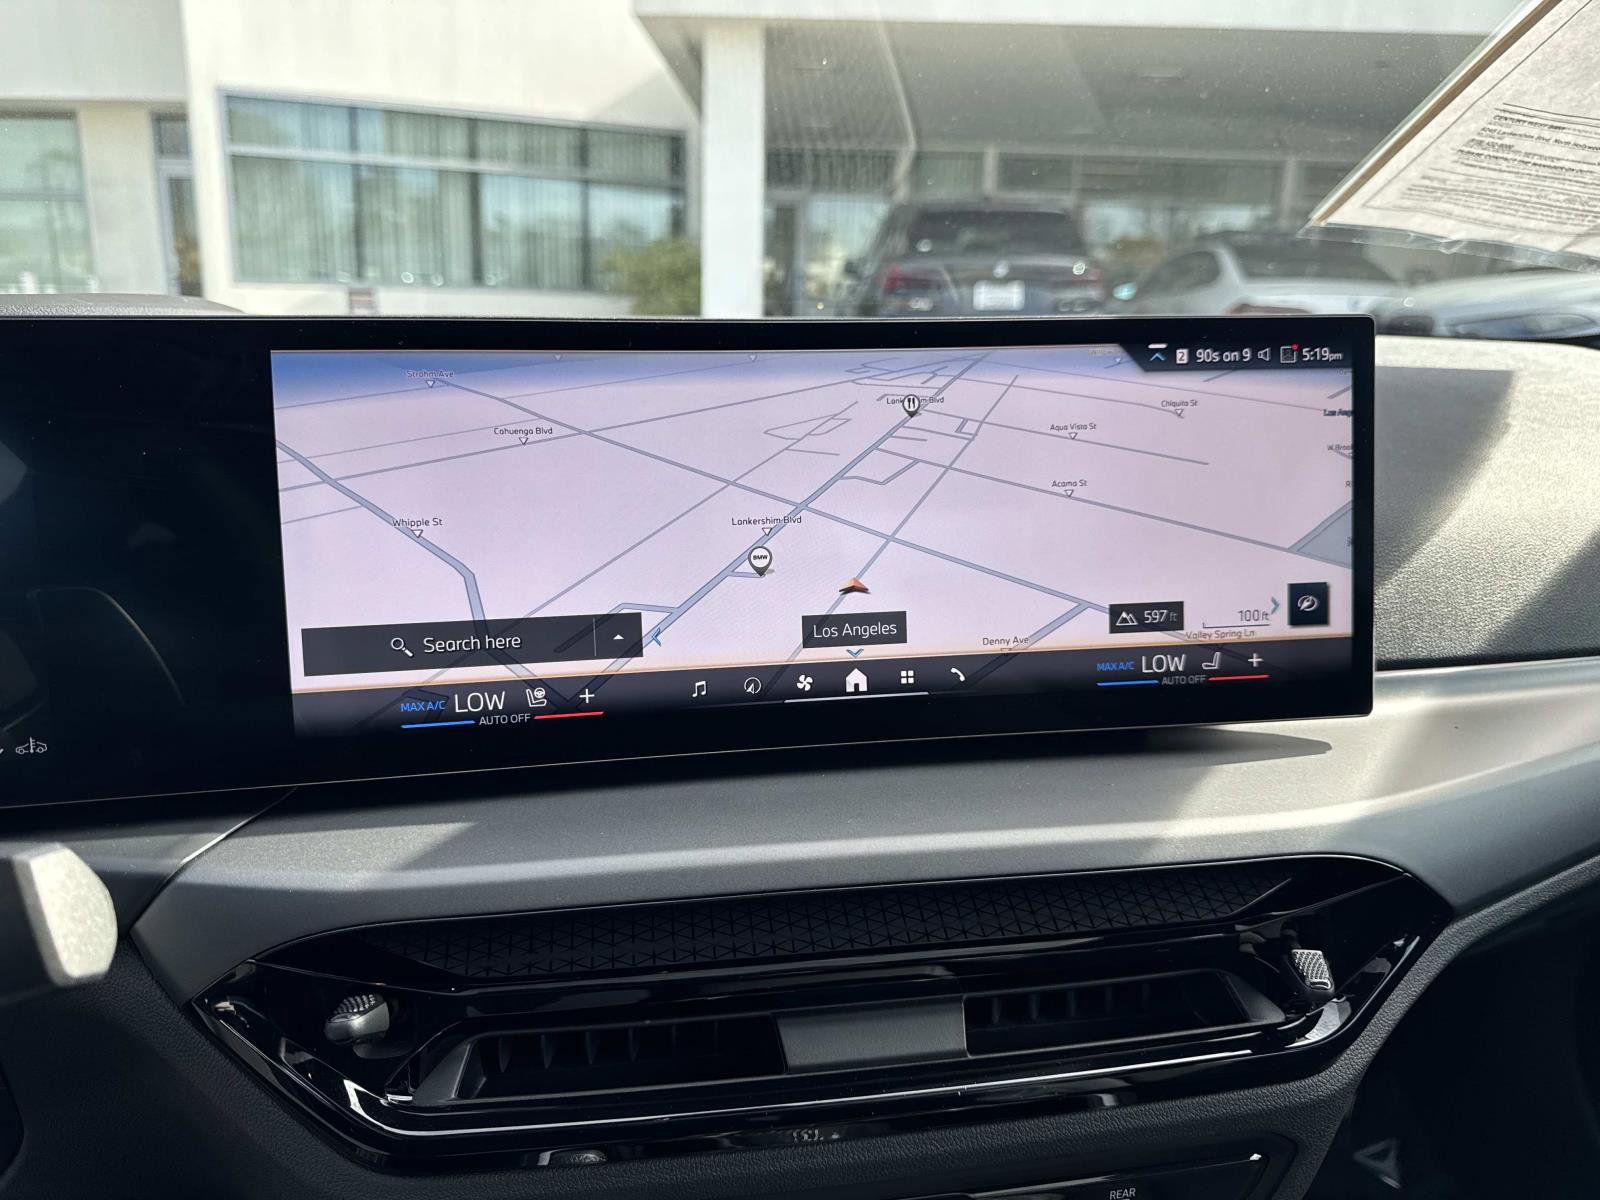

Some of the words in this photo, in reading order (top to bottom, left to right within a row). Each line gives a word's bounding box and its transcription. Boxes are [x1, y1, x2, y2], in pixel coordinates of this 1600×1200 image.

[1196, 349, 1219, 362] 90s
[1222, 351, 1239, 362] on
[1242, 348, 1250, 362] 9
[1190, 399, 1198, 407] St
[493, 427, 534, 436] Cahuenga
[535, 427, 553, 435] Blvd
[1069, 423, 1088, 431] Vista
[1052, 480, 1077, 488] Acama
[1079, 479, 1088, 487] St
[392, 519, 430, 529] Whipple
[432, 518, 443, 526] St
[731, 517, 782, 526] Lankershim
[783, 516, 802, 524] Blvd
[1144, 610, 1168, 624] 597
[1169, 611, 1178, 622] ft
[1238, 610, 1260, 622] 100
[813, 624, 838, 638] Los
[842, 622, 897, 639] Angeles
[1185, 631, 1213, 640] Valley
[1214, 630, 1242, 640] Spring
[423, 636, 481, 653] Search
[485, 635, 521, 649] here
[982, 638, 1011, 646] Denny
[1012, 636, 1029, 645] Ave
[1096, 663, 1117, 671] MAX
[1118, 661, 1135, 670] A/C
[1141, 653, 1187, 673] LOW
[1161, 676, 1186, 685] AUTO
[1187, 674, 1206, 683] OFF
[400, 702, 425, 712] MAX
[426, 700, 446, 710] A/C
[454, 691, 506, 713] LOW
[478, 715, 508, 726] AUTO
[510, 713, 531, 724] OFF
[1109, 1187, 1136, 1200] REAR
